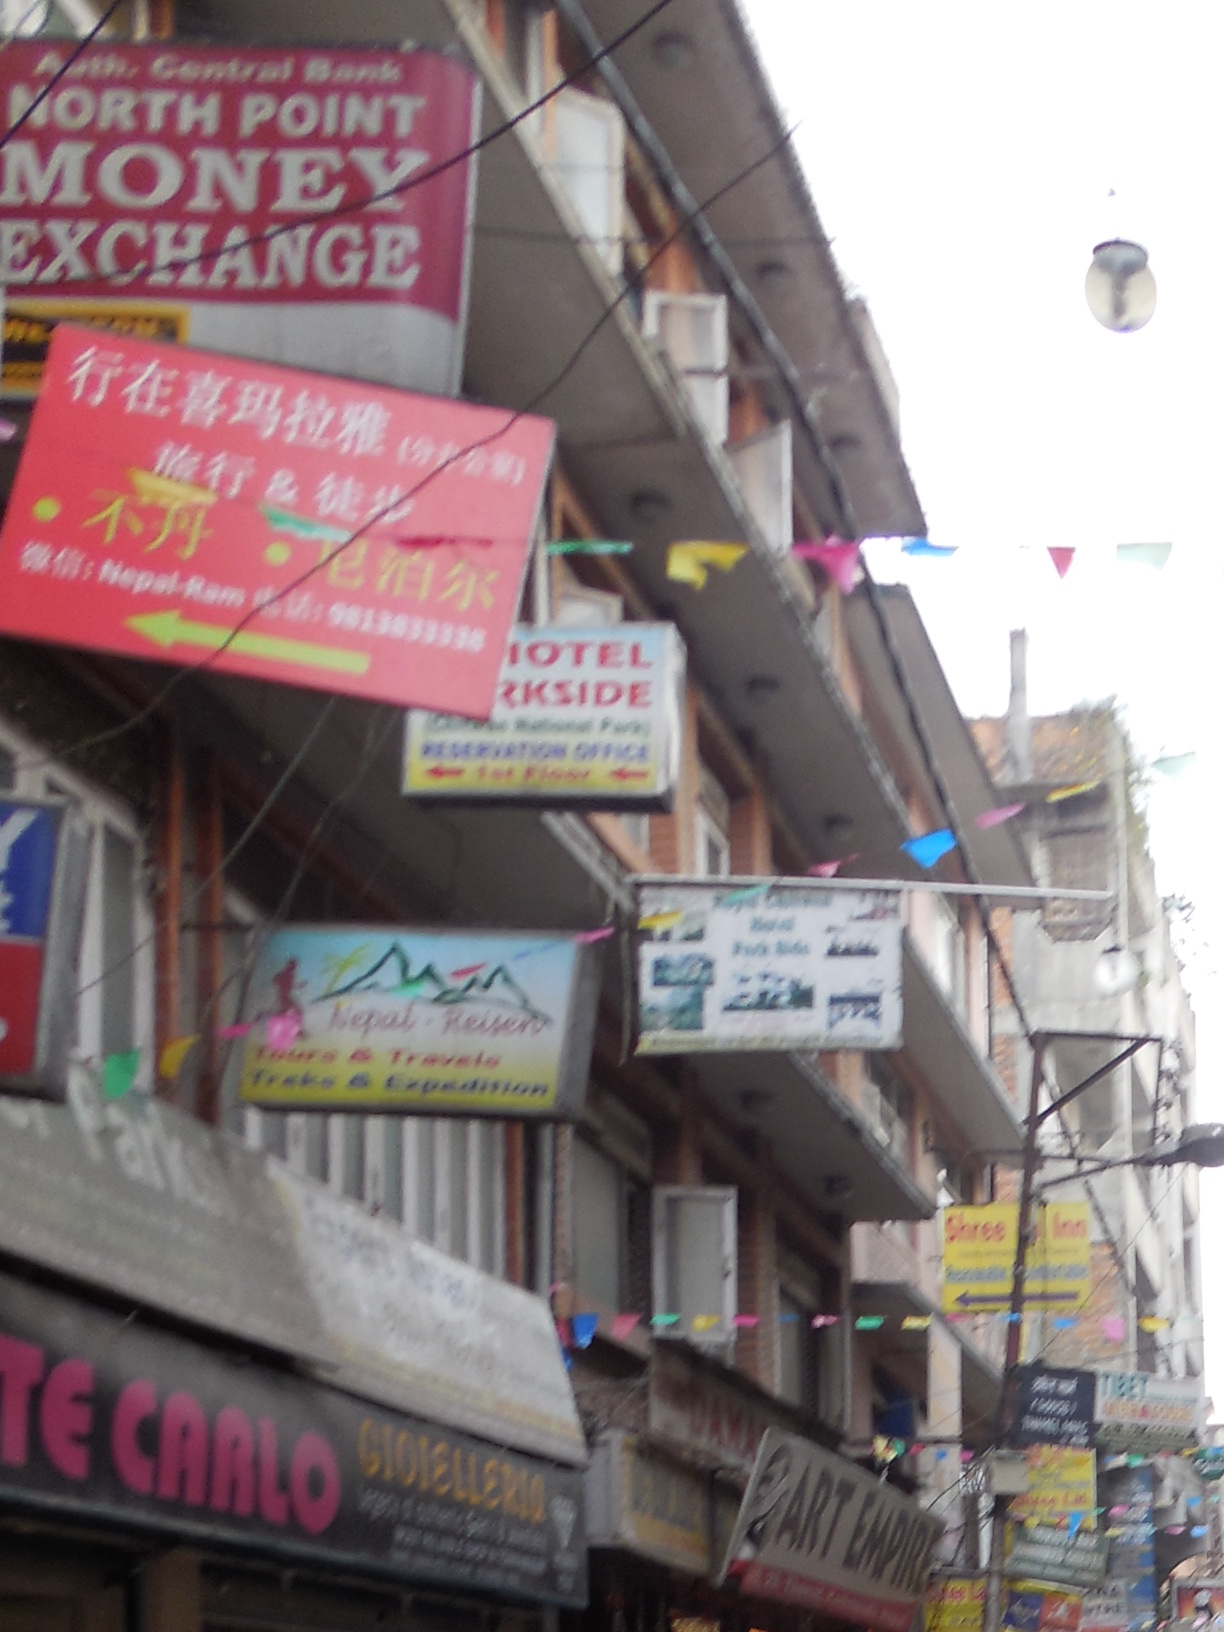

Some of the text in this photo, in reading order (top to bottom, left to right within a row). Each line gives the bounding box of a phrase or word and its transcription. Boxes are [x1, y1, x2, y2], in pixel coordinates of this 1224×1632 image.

[150, 54, 293, 83] Central
[304, 58, 402, 83] Bank
[7, 85, 428, 138] NORTH POINT
[0, 140, 431, 213] MONEY
[0, 217, 422, 290] EXCHANGE
[264, 467, 300, 503] &
[422, 740, 649, 763] RESERVATION OFFICE
[523, 764, 591, 782] Floor
[254, 1048, 502, 1069] Tours & Travels
[346, 1072, 371, 1090] &
[383, 1072, 550, 1099] Expedition
[945, 1212, 1007, 1245] Shree
[1051, 1216, 1088, 1241] Inn
[112, 1379, 341, 1535] CARLO
[356, 1416, 547, 1525] GIOIELLERIA
[775, 1457, 858, 1562] ART
